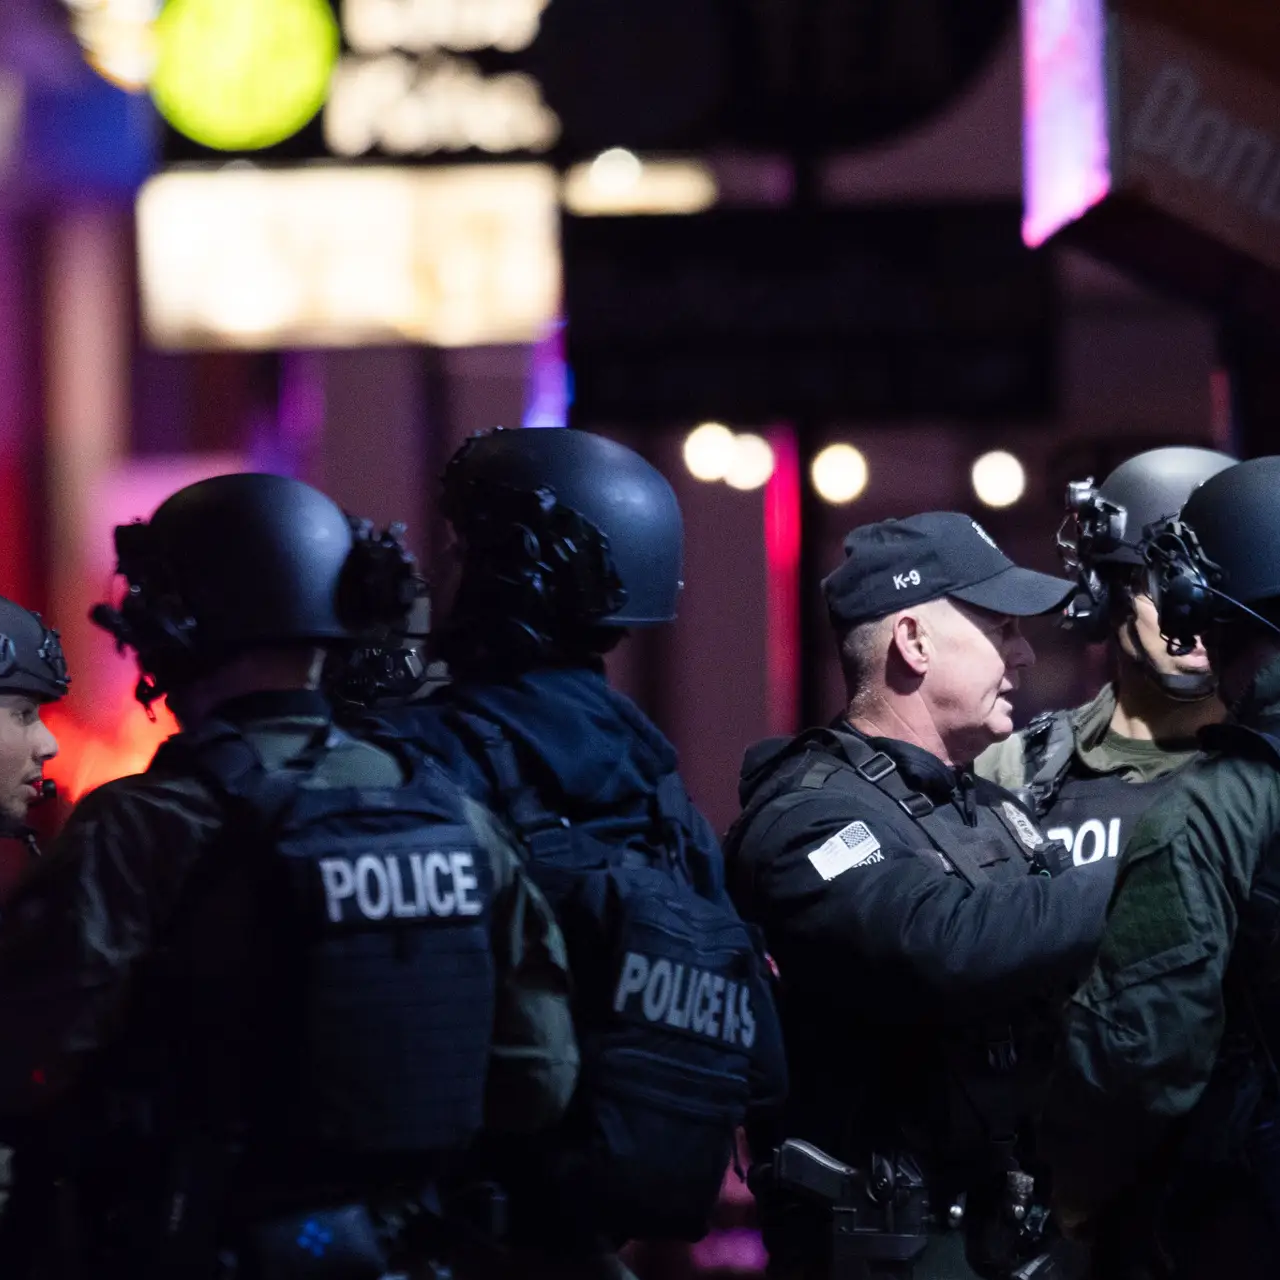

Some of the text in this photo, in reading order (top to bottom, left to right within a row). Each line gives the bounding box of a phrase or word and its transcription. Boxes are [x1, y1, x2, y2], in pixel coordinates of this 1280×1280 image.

[892, 568, 921, 591] K-9
[319, 851, 484, 923] POLICE
[612, 951, 726, 1038] POLICE
